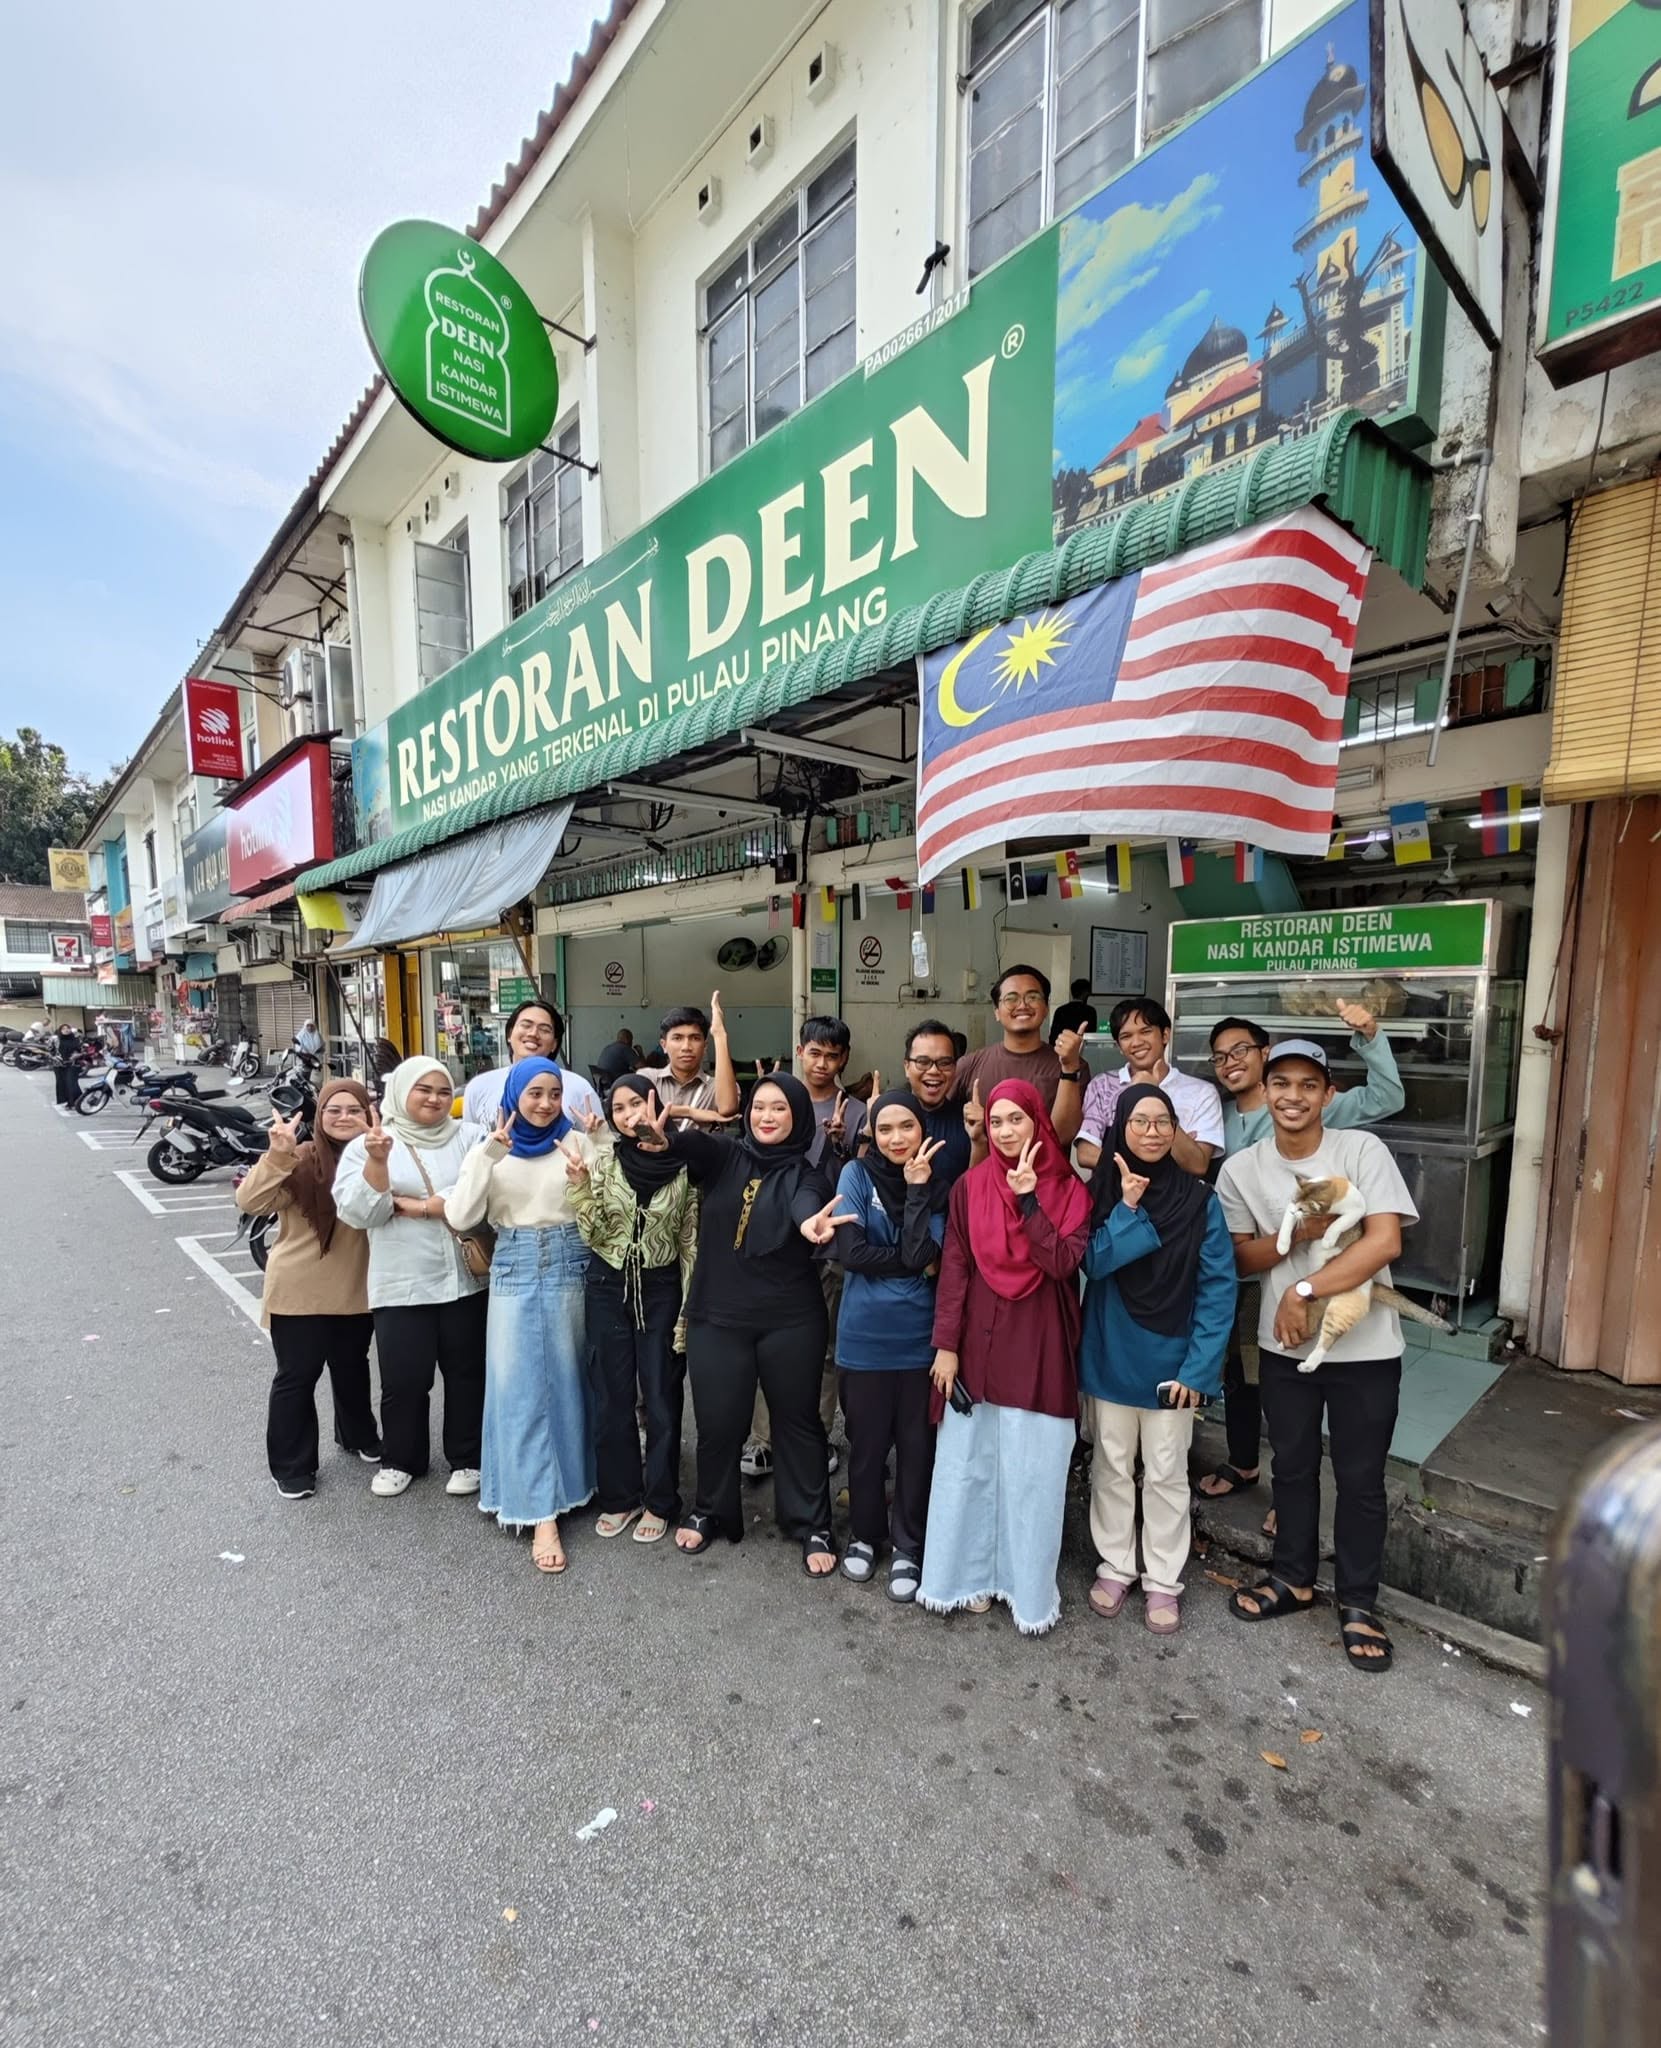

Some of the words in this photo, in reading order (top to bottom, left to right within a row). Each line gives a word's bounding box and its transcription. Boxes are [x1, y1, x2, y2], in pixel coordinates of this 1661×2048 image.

[435, 291, 500, 333] RESTORAN
[1565, 281, 1643, 328] P5422
[441, 316, 496, 359] DEEN
[864, 284, 970, 376] PA002661/2017
[453, 349, 485, 373] NASI
[441, 363, 497, 400] KANDAR
[436, 382, 503, 422] ISTIMEWA
[397, 578, 653, 807] RESTORAN
[685, 354, 996, 661] DEEN
[423, 800, 446, 821] NASI
[450, 772, 497, 809] KANDAR
[500, 751, 539, 783] YANG
[542, 714, 632, 767] TERKENAL
[638, 693, 659, 727] DI
[667, 650, 750, 715] PULAU
[762, 586, 888, 673] PINANG
[196, 733, 235, 747] hotlink
[1241, 915, 1333, 938] RESTORAN
[1342, 912, 1393, 932] DEEN
[1207, 942, 1244, 960] NASI
[1252, 938, 1324, 958] KANDAR
[1332, 932, 1433, 954] ISTIMEWA
[1266, 958, 1306, 971] PULAU
[1311, 957, 1358, 970] PINANG
